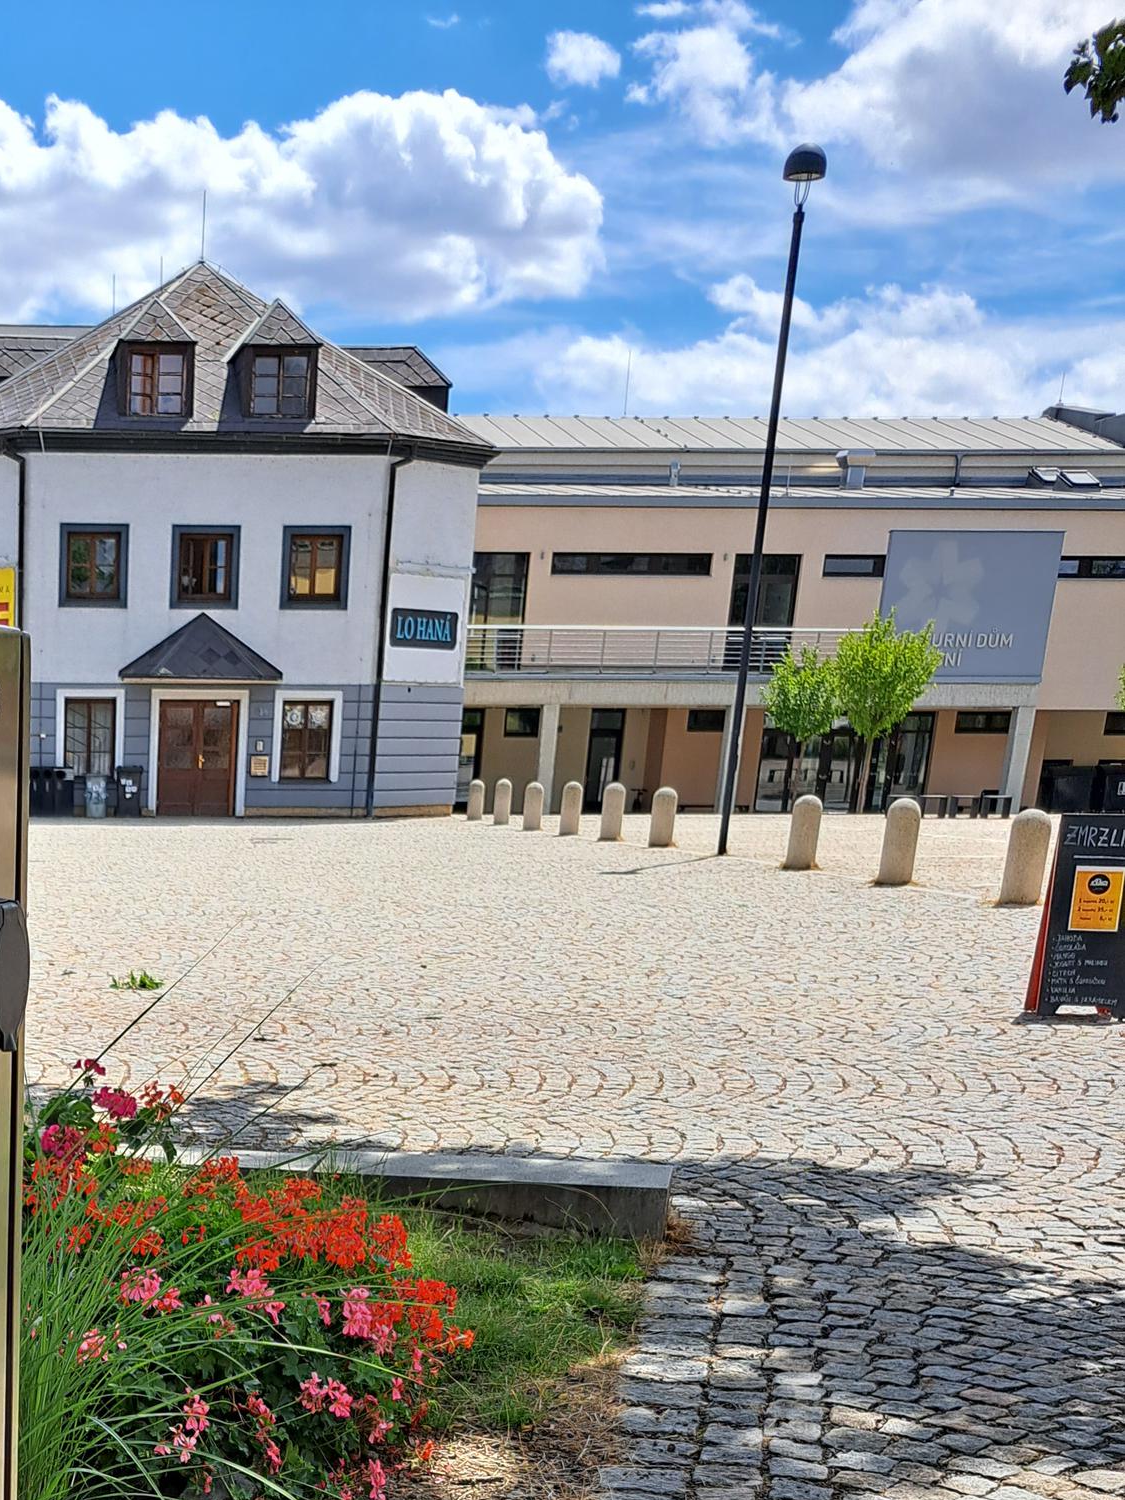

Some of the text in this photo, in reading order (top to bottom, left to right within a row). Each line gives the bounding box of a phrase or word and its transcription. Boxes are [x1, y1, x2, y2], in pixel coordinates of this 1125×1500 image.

[396, 614, 452, 642] LO HANÁ
[976, 624, 1014, 648] DŮM
